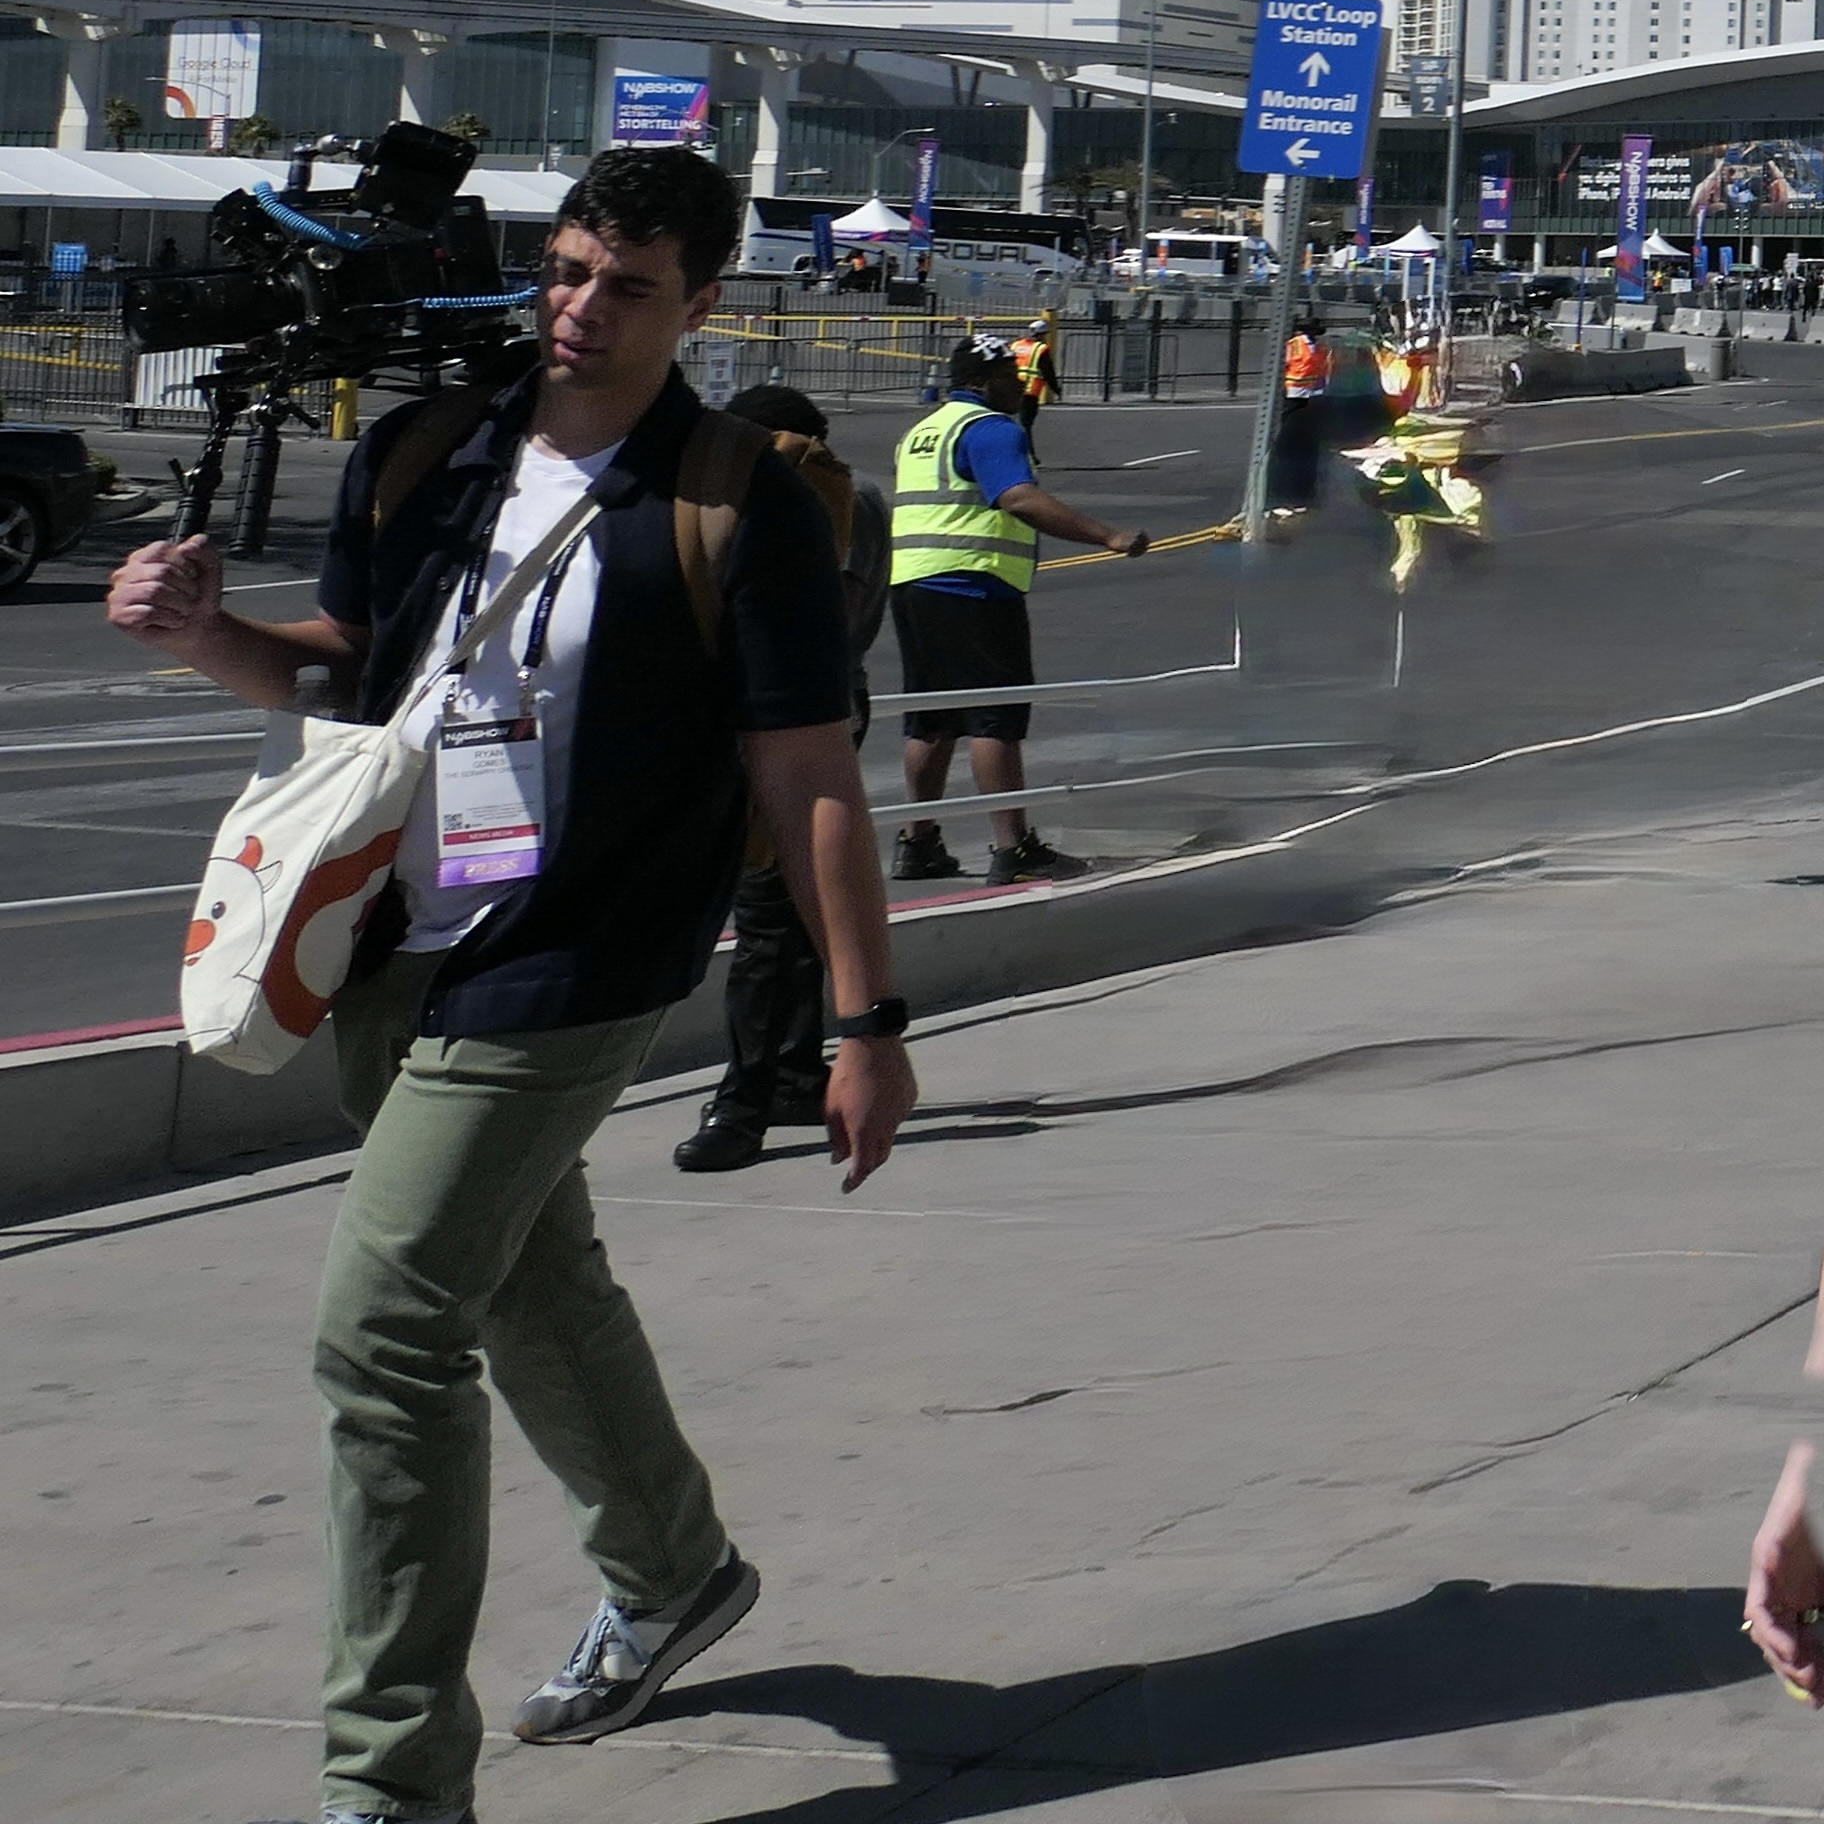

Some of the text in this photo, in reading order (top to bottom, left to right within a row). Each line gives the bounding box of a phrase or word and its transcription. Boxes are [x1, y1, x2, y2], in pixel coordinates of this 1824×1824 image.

[1266, 1, 1378, 29] LVCC Loop
[1280, 25, 1358, 46] Station
[1261, 90, 1359, 112] Monorail
[1422, 96, 1436, 112] 2
[619, 119, 702, 130] STORYTELLING
[1258, 113, 1353, 135] Entrance
[1666, 154, 1690, 171] gives
[1625, 151, 1644, 231] NABSHOW
[932, 243, 1042, 264] ROYAL
